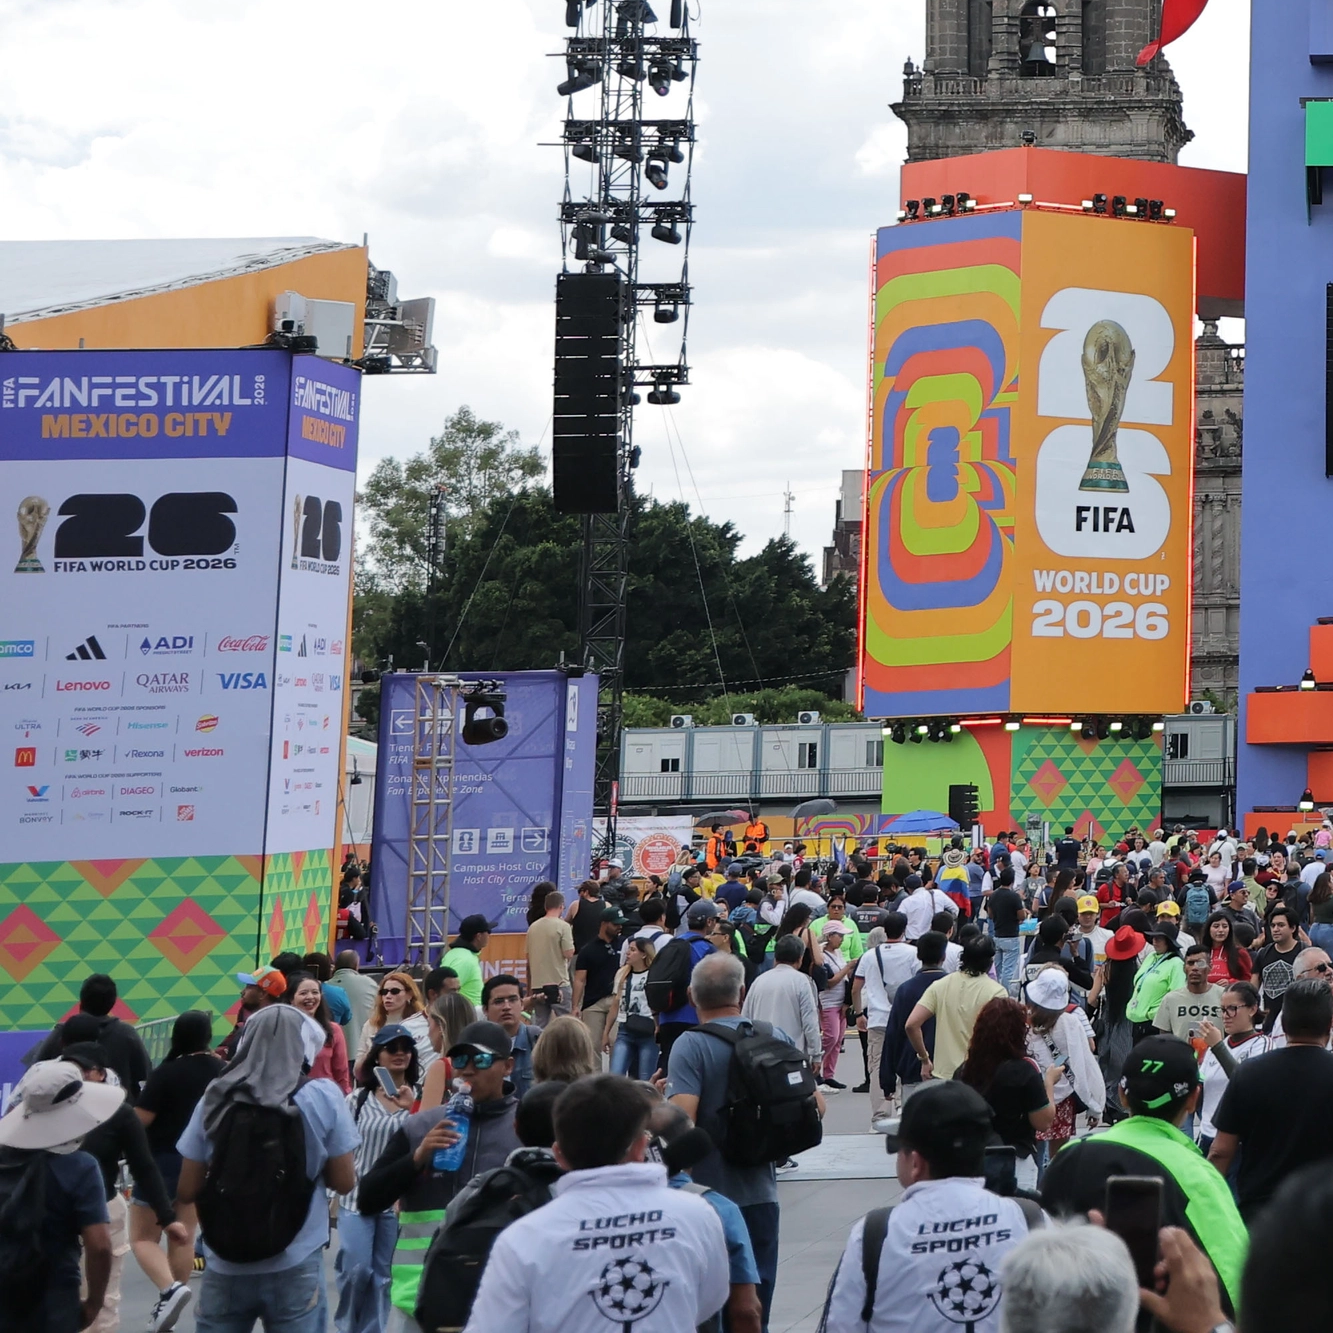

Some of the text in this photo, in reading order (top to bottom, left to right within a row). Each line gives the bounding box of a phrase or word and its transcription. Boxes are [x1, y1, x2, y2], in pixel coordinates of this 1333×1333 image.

[2, 377, 15, 408] FIFA
[254, 374, 266, 406] 2026
[41, 412, 232, 438] MEXICO CITY
[302, 415, 346, 449] MEXICO CITY
[54, 492, 238, 558] 26
[1075, 505, 1136, 533] FIFA
[301, 495, 342, 562] 26
[54, 558, 237, 573] FIFA WORLD CUP 2026
[1033, 569, 1170, 596] WORLD CUP
[1031, 599, 1170, 640] 2026
[154, 636, 194, 649] ADI
[56, 680, 110, 691] Lenovo
[136, 672, 189, 687] QATAR
[215, 672, 267, 689] VISA
[149, 685, 189, 693] AIRWAYS
[132, 750, 164, 758] Rexona
[184, 748, 223, 757] verizon
[389, 756, 408, 764] FIFA
[388, 775, 412, 783] Zona
[434, 773, 492, 784] xperiencias
[120, 786, 155, 795] DIAGEO
[387, 787, 404, 795] Fan
[460, 785, 483, 794] Zone
[454, 861, 545, 873] Campus Host City
[463, 874, 545, 885] Host City Campus
[1178, 1005, 1219, 1018] BOSS
[1141, 1059, 1164, 1073] 77
[580, 1210, 663, 1231] LUCHO
[918, 1214, 998, 1235] LUCHO
[572, 1227, 677, 1251] SPORTS
[911, 1229, 1011, 1254] SPORTS
